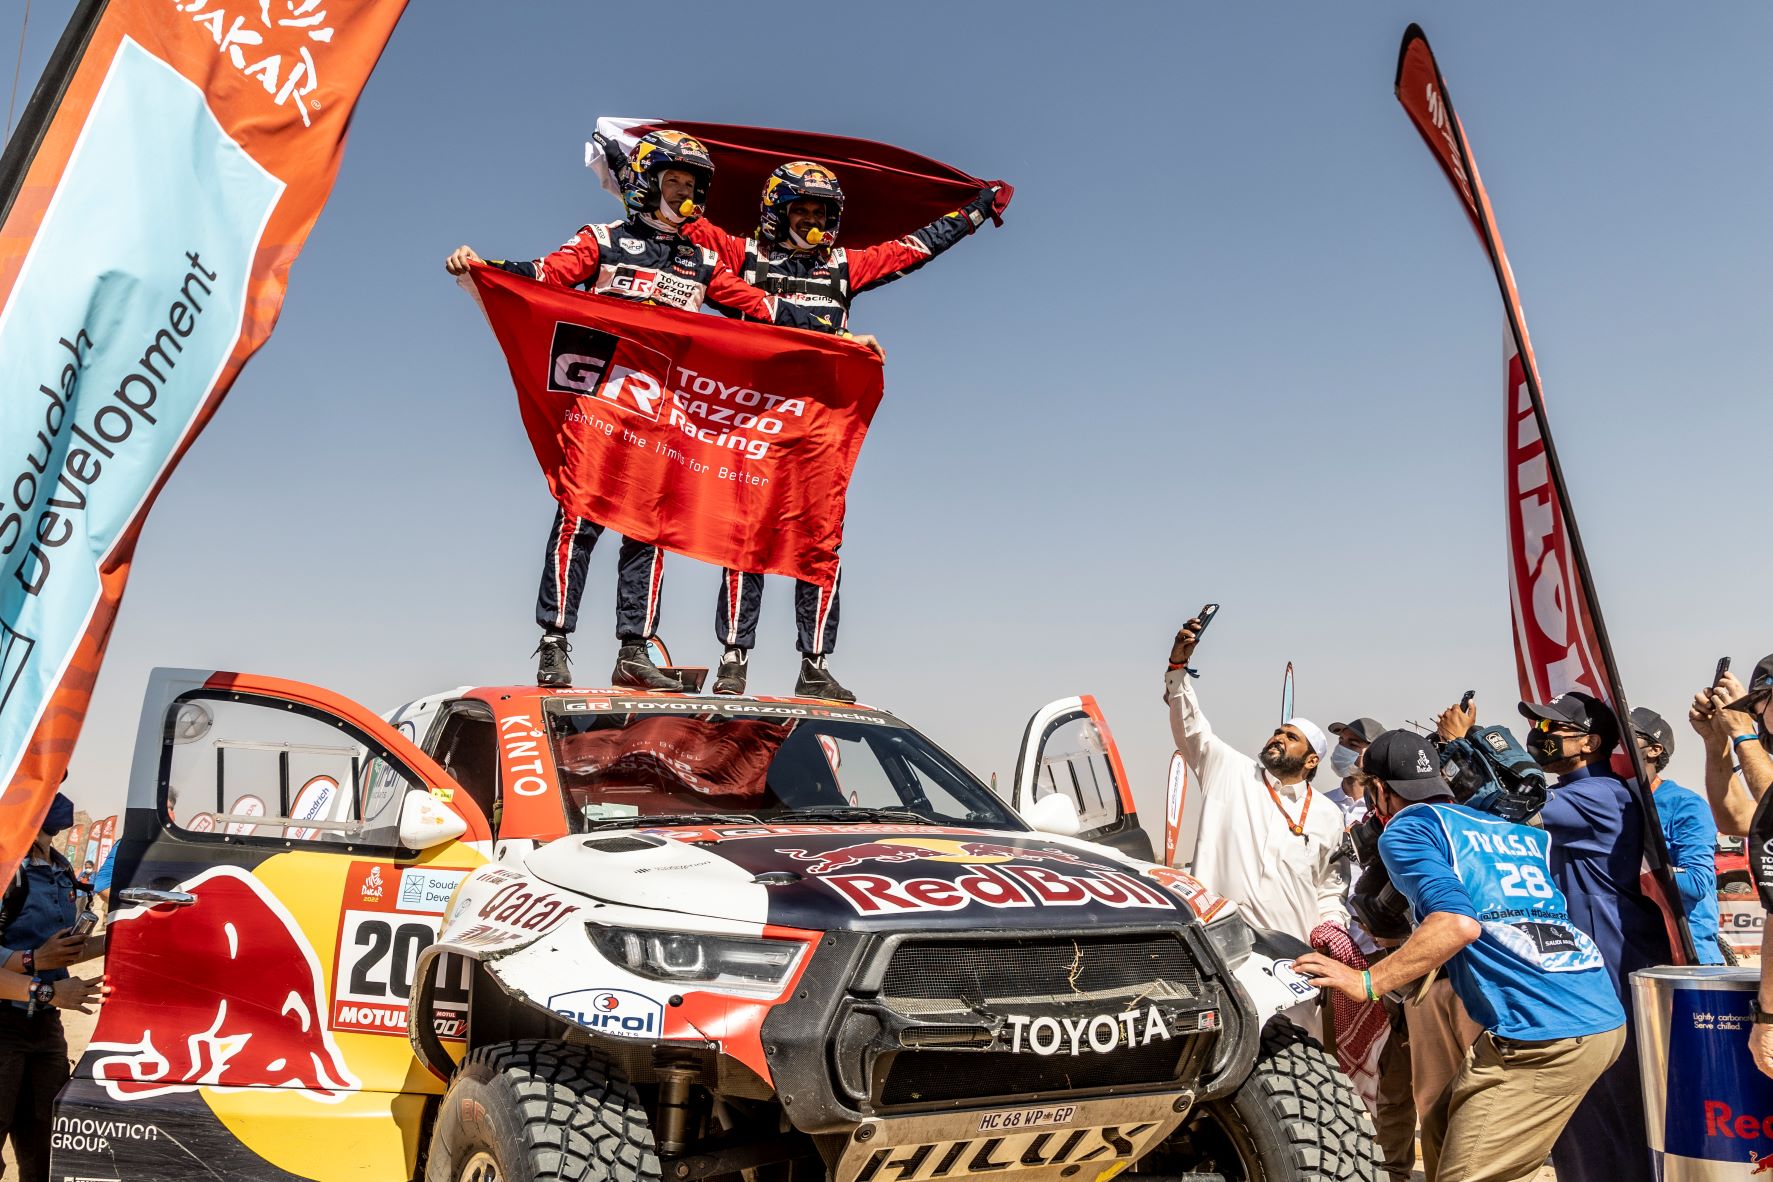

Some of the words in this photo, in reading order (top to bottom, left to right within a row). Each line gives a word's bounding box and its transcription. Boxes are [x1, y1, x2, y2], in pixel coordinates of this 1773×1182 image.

[174, 0, 318, 127] AKAR
[611, 277, 655, 293] GR
[653, 288, 688, 307] Racing
[796, 292, 833, 304] Racing
[554, 353, 661, 415] GR
[676, 365, 806, 417] TOYOTA
[14, 250, 217, 597] Development
[672, 389, 783, 435] GAZOO
[0, 328, 94, 555] Soudah
[668, 407, 771, 460] Racing
[564, 409, 614, 436] Pushing
[623, 428, 647, 448] the
[689, 458, 710, 475] for
[718, 466, 769, 488] Better
[566, 702, 610, 711] GR
[618, 701, 719, 711] TOYOTA
[724, 703, 808, 716] GAZOO
[811, 709, 886, 725] Racing
[1462, 830, 1494, 853] TV
[1495, 862, 1553, 899] 28
[478, 882, 581, 932] Qatar
[1480, 908, 1525, 922] @Dakar
[338, 1006, 408, 1028] MOTUL
[433, 1018, 468, 1037] 00V
[555, 1009, 654, 1032] eurol
[1692, 1012, 1715, 1022] Lightly
[1693, 1021, 1714, 1030] Serve
[1716, 1021, 1743, 1030] chilled.
[1006, 1004, 1171, 1056] TOYOTA
[980, 1114, 1001, 1129] HC
[1002, 1112, 1022, 1127] 68
[1024, 1110, 1044, 1125] WP
[1053, 1107, 1074, 1122] GP
[51, 1133, 109, 1153] GROUP
[852, 1121, 1160, 1182] HILUX
